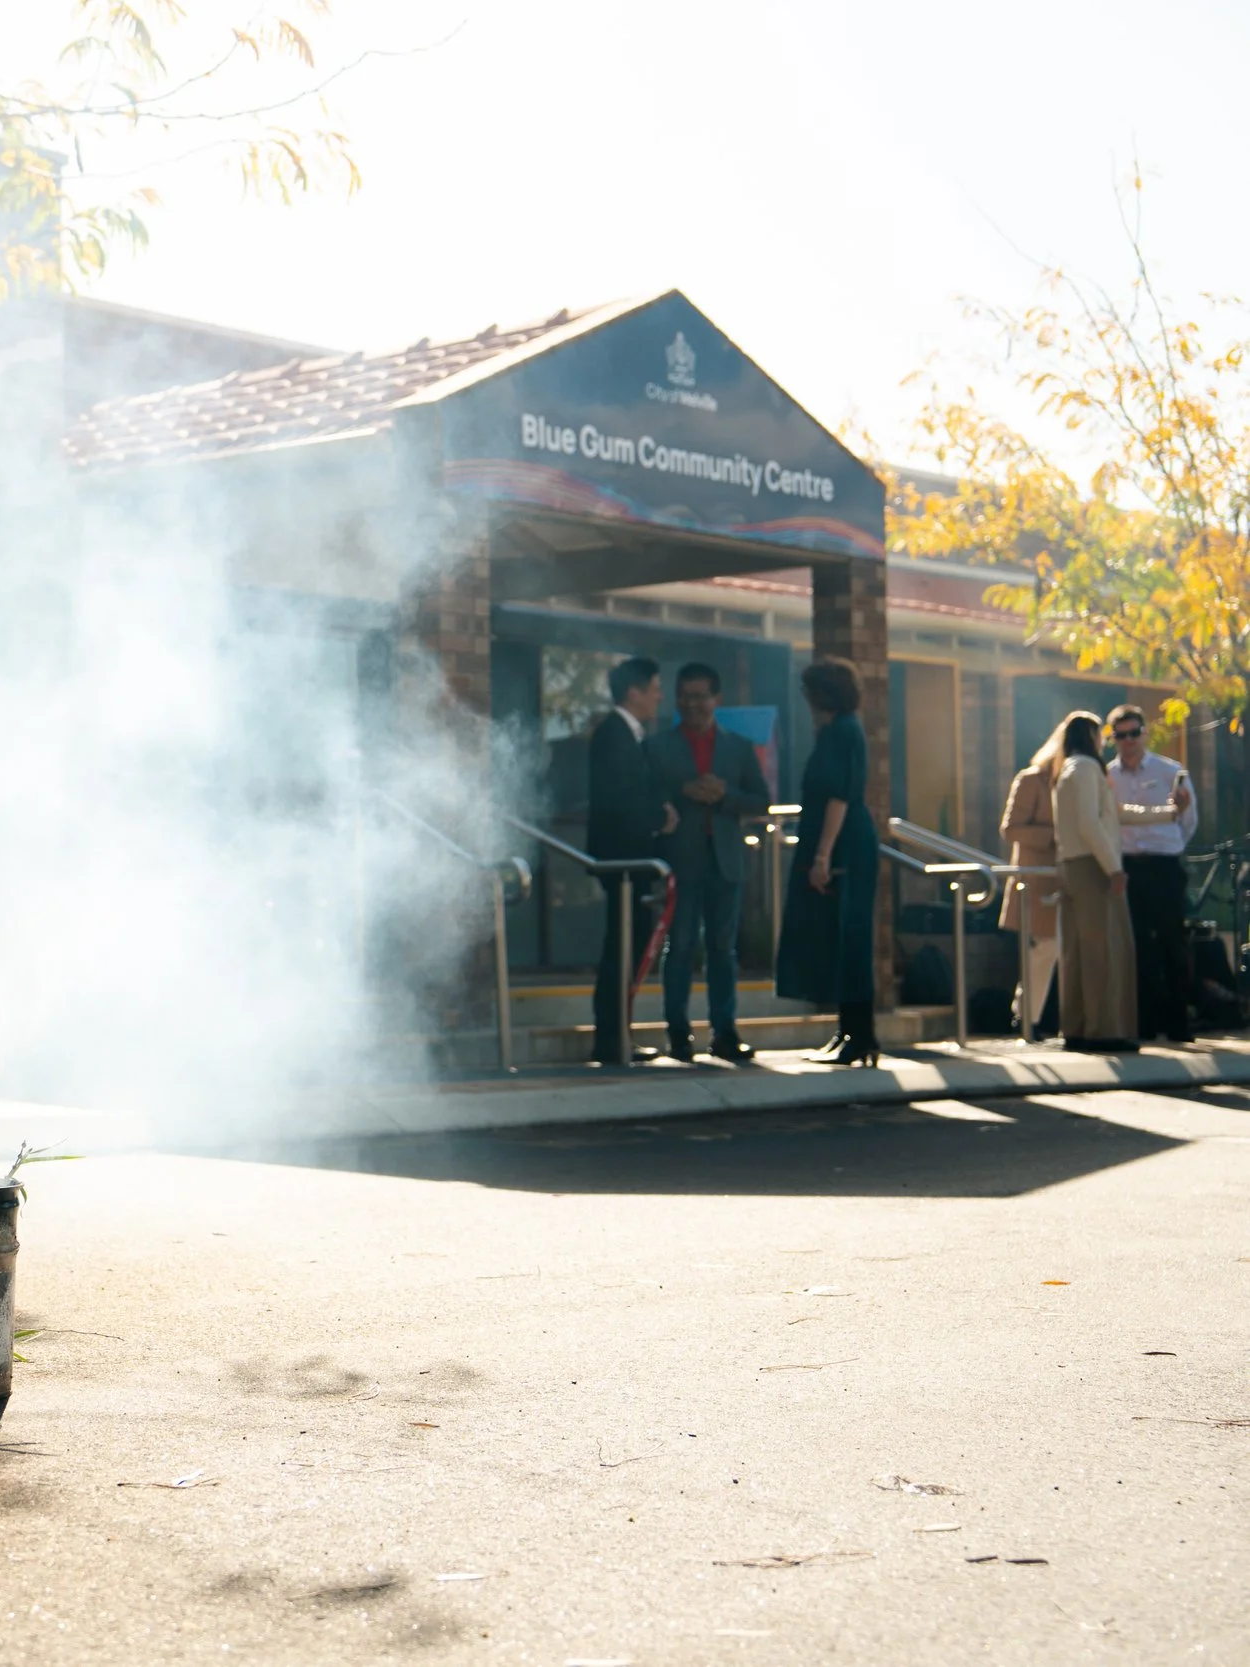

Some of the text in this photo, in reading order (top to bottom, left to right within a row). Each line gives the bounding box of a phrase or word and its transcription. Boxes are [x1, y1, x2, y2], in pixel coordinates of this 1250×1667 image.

[521, 413, 834, 501] Blue Gum Community Centre
